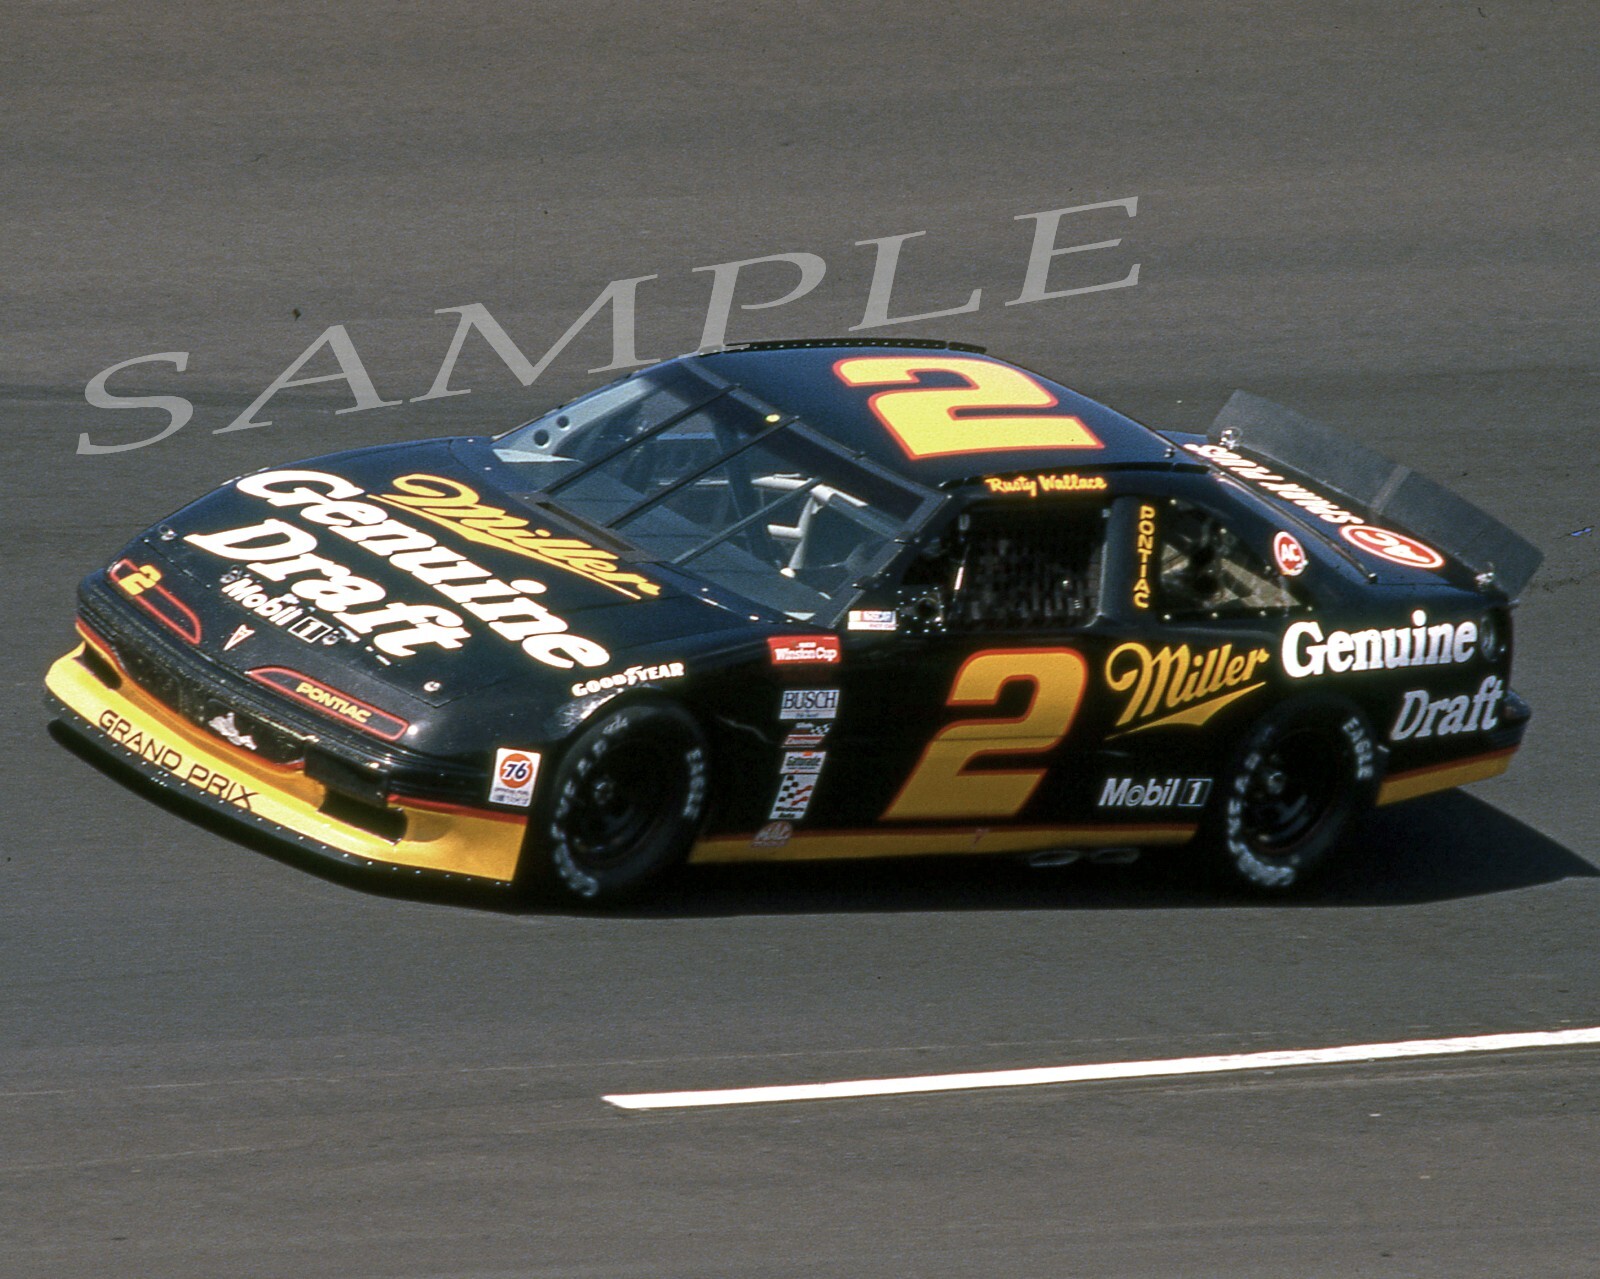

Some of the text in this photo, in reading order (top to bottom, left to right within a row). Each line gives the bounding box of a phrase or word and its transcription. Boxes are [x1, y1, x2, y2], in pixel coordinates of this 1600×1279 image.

[832, 356, 1105, 461] 2
[984, 474, 1108, 497] Rusty Wallace
[236, 469, 611, 669] Genuine
[378, 473, 662, 598] Miller
[1133, 504, 1156, 609] PONTIAC
[118, 565, 162, 596] 2
[183, 518, 472, 658] Draft
[221, 577, 303, 626] Mobil
[1281, 610, 1479, 678] Genuine
[296, 681, 372, 723] PONTIAC
[571, 662, 685, 697] GOODYEAR
[783, 691, 838, 710] BUSCH
[1105, 642, 1270, 728] Miller
[1390, 675, 1503, 741] Draft
[98, 708, 263, 810] GRAND PRIX
[879, 646, 1089, 821] 2
[503, 761, 529, 781] 76
[1099, 777, 1178, 807] Mobil
